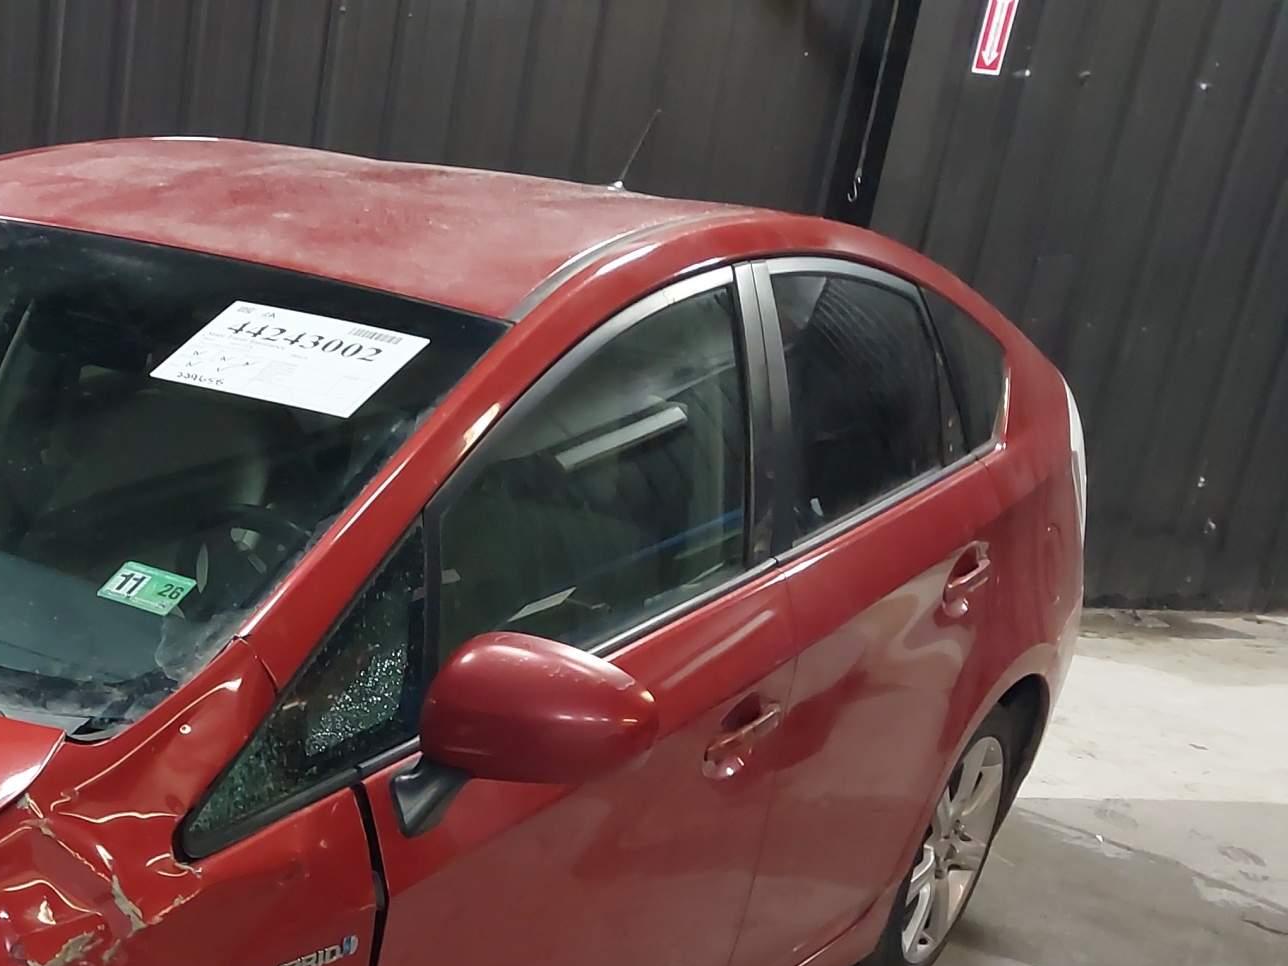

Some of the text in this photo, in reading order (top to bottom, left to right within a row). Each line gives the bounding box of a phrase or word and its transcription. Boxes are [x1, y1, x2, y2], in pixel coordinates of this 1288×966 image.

[228, 321, 383, 362] 44243002
[116, 572, 146, 595] 11
[157, 583, 184, 600] 26
